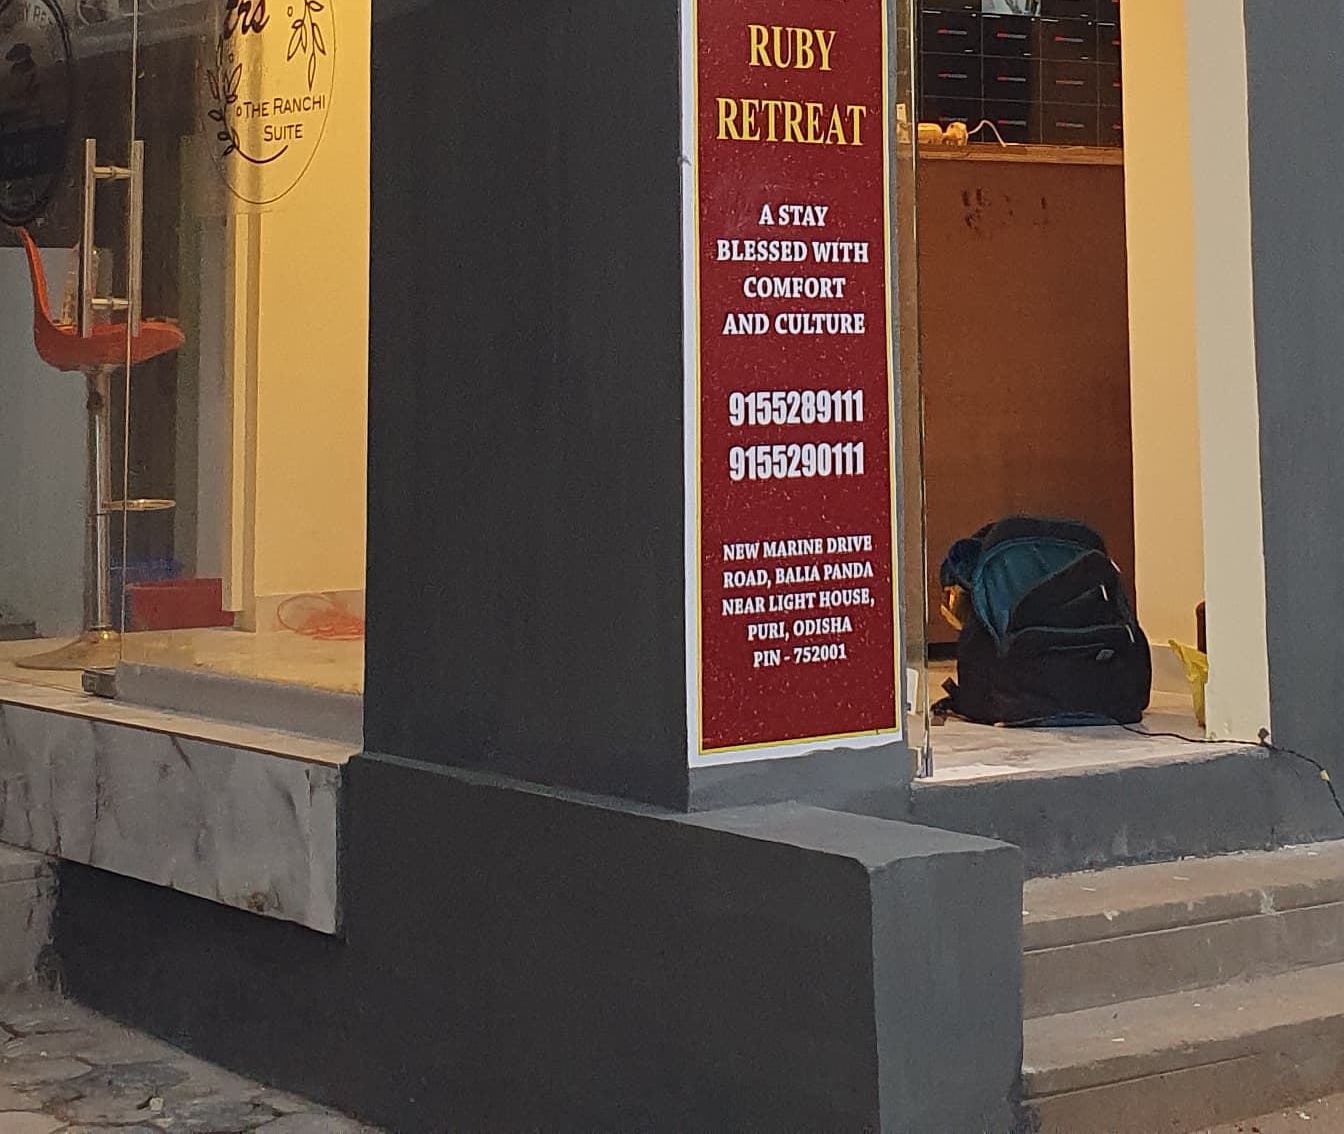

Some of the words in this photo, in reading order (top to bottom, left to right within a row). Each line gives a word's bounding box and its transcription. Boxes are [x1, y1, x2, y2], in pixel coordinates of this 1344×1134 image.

[747, 24, 837, 71] RUBY
[243, 101, 270, 118] THE
[273, 95, 326, 116] RANCHI
[263, 123, 303, 142] SUITE
[716, 97, 867, 146] RETREAT
[758, 204, 775, 226] A
[778, 204, 829, 227] STAY
[717, 239, 807, 262] BLESSED
[811, 241, 870, 263] WITH
[743, 276, 846, 298] COMFORT
[722, 313, 770, 335] AND
[774, 313, 866, 335] CULTURE
[729, 389, 864, 426] 9155289111
[729, 442, 865, 481] 9155290111
[722, 542, 760, 561] NEW
[763, 538, 824, 558] MARINE
[826, 535, 873, 554] DRIVE
[722, 569, 772, 589] ROAD,
[775, 565, 820, 585] BALIA
[823, 561, 874, 581] PANDA
[722, 596, 766, 616] NEAR
[769, 592, 816, 612] LIGHT
[819, 587, 876, 607] HOUSE,
[747, 622, 790, 641] PURI,
[793, 616, 852, 636] ODISHA
[753, 649, 781, 668] PIN
[794, 643, 848, 664] 752001
